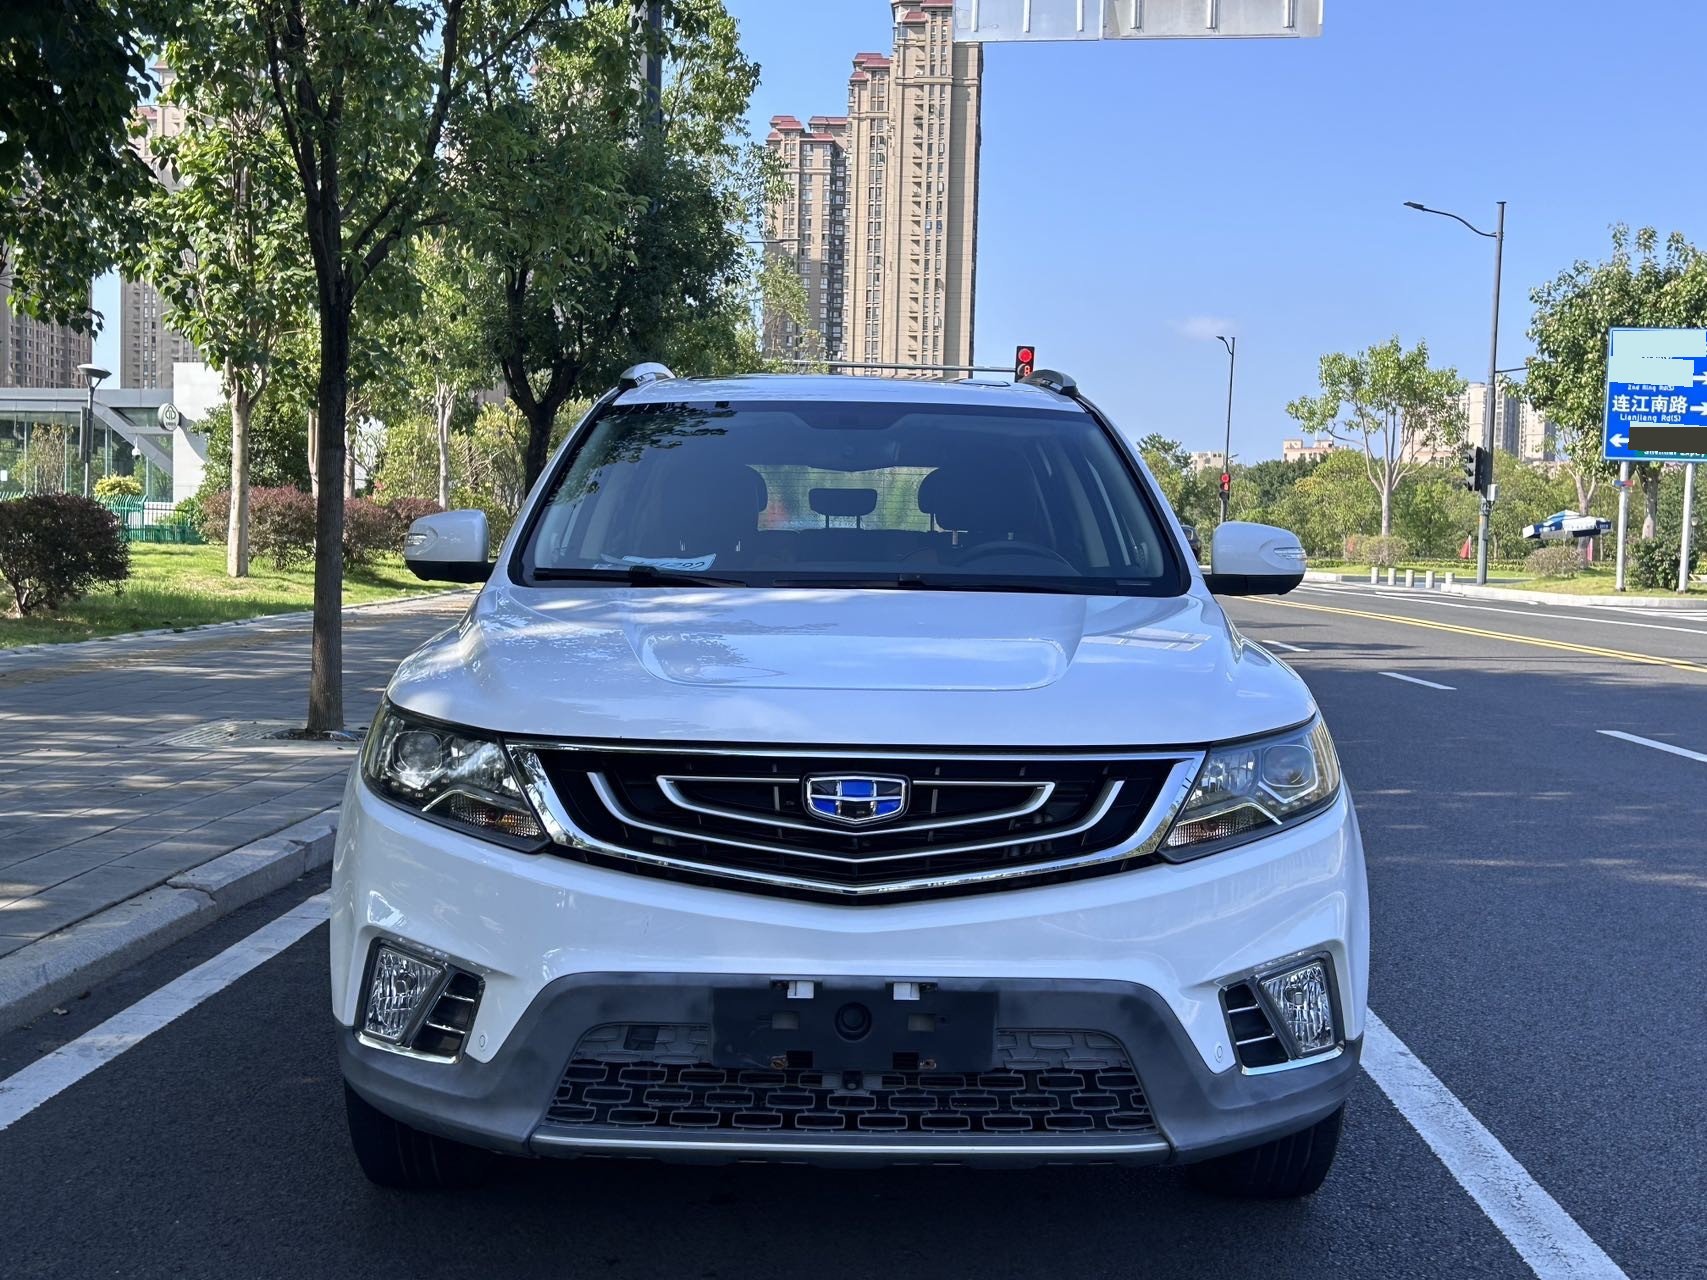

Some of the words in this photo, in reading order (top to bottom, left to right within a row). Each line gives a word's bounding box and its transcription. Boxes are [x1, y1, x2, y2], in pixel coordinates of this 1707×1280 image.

[1612, 394, 1688, 414] 连江南路
[1620, 413, 1657, 423] Lianjiang
[1661, 414, 1682, 422] Rd(S)
